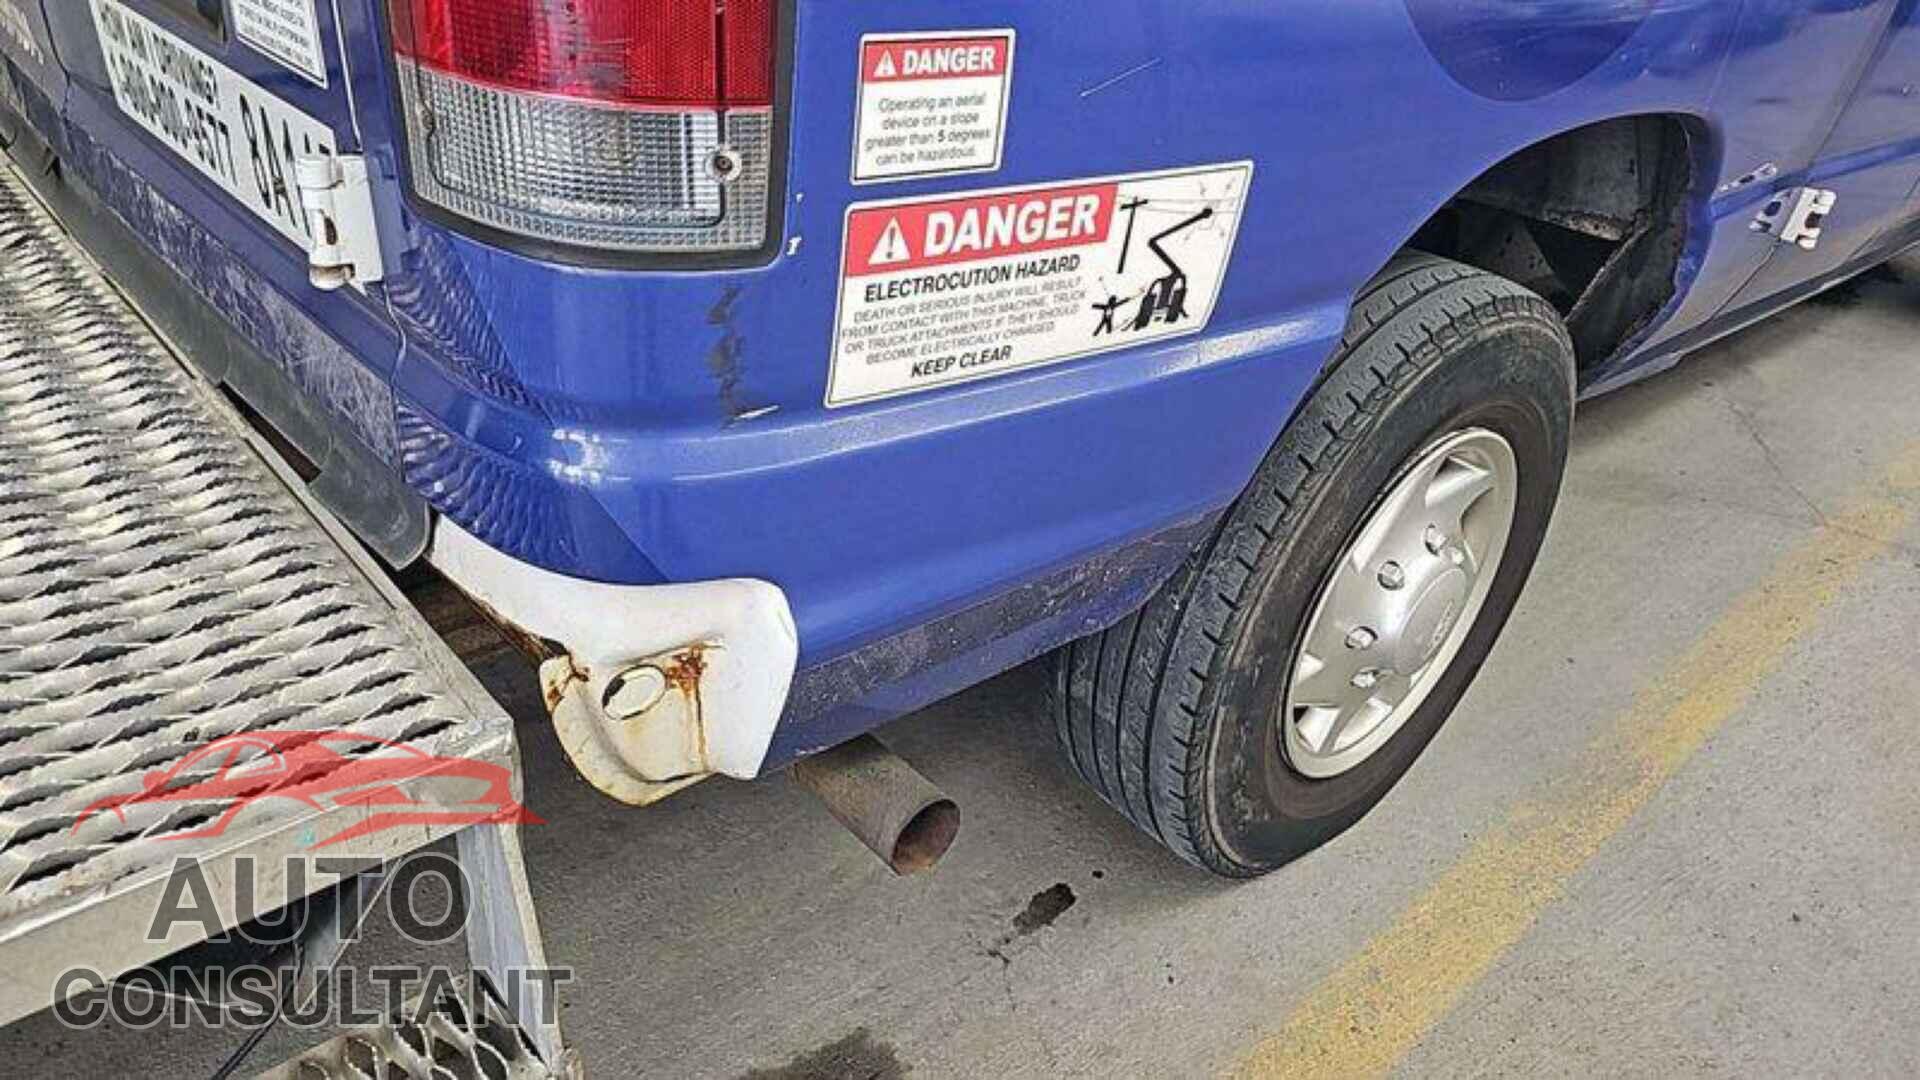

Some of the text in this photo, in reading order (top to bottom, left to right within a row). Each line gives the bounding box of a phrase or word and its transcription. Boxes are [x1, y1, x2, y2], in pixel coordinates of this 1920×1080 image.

[902, 46, 996, 75] DANGER
[878, 92, 987, 112] Operating an aerial
[882, 112, 980, 130] device on a slope
[865, 128, 991, 152] greater than 5 degrees
[876, 153, 899, 166] can
[900, 150, 915, 164] be
[923, 193, 1101, 259] DANGER
[864, 254, 1081, 302] ELECTROCUTION HAZARD
[842, 324, 878, 339] FROM
[880, 314, 937, 334] CONTACT
[939, 310, 970, 324] WITH
[971, 304, 997, 317] THIS
[1052, 289, 1086, 304] TRUCK
[853, 276, 1082, 324] DEATH OR SERIOUS INJURY WILL RESULT
[845, 340, 865, 353] OR
[867, 334, 908, 350] TRUCK
[909, 319, 992, 344] ATTACHMENTS
[1006, 311, 1036, 324] THEY
[1036, 303, 1080, 320] SHOULD
[866, 346, 917, 365] BECOME
[919, 332, 1000, 356] ELECTRICALLY
[910, 345, 1012, 378] KEEP CLEAR
